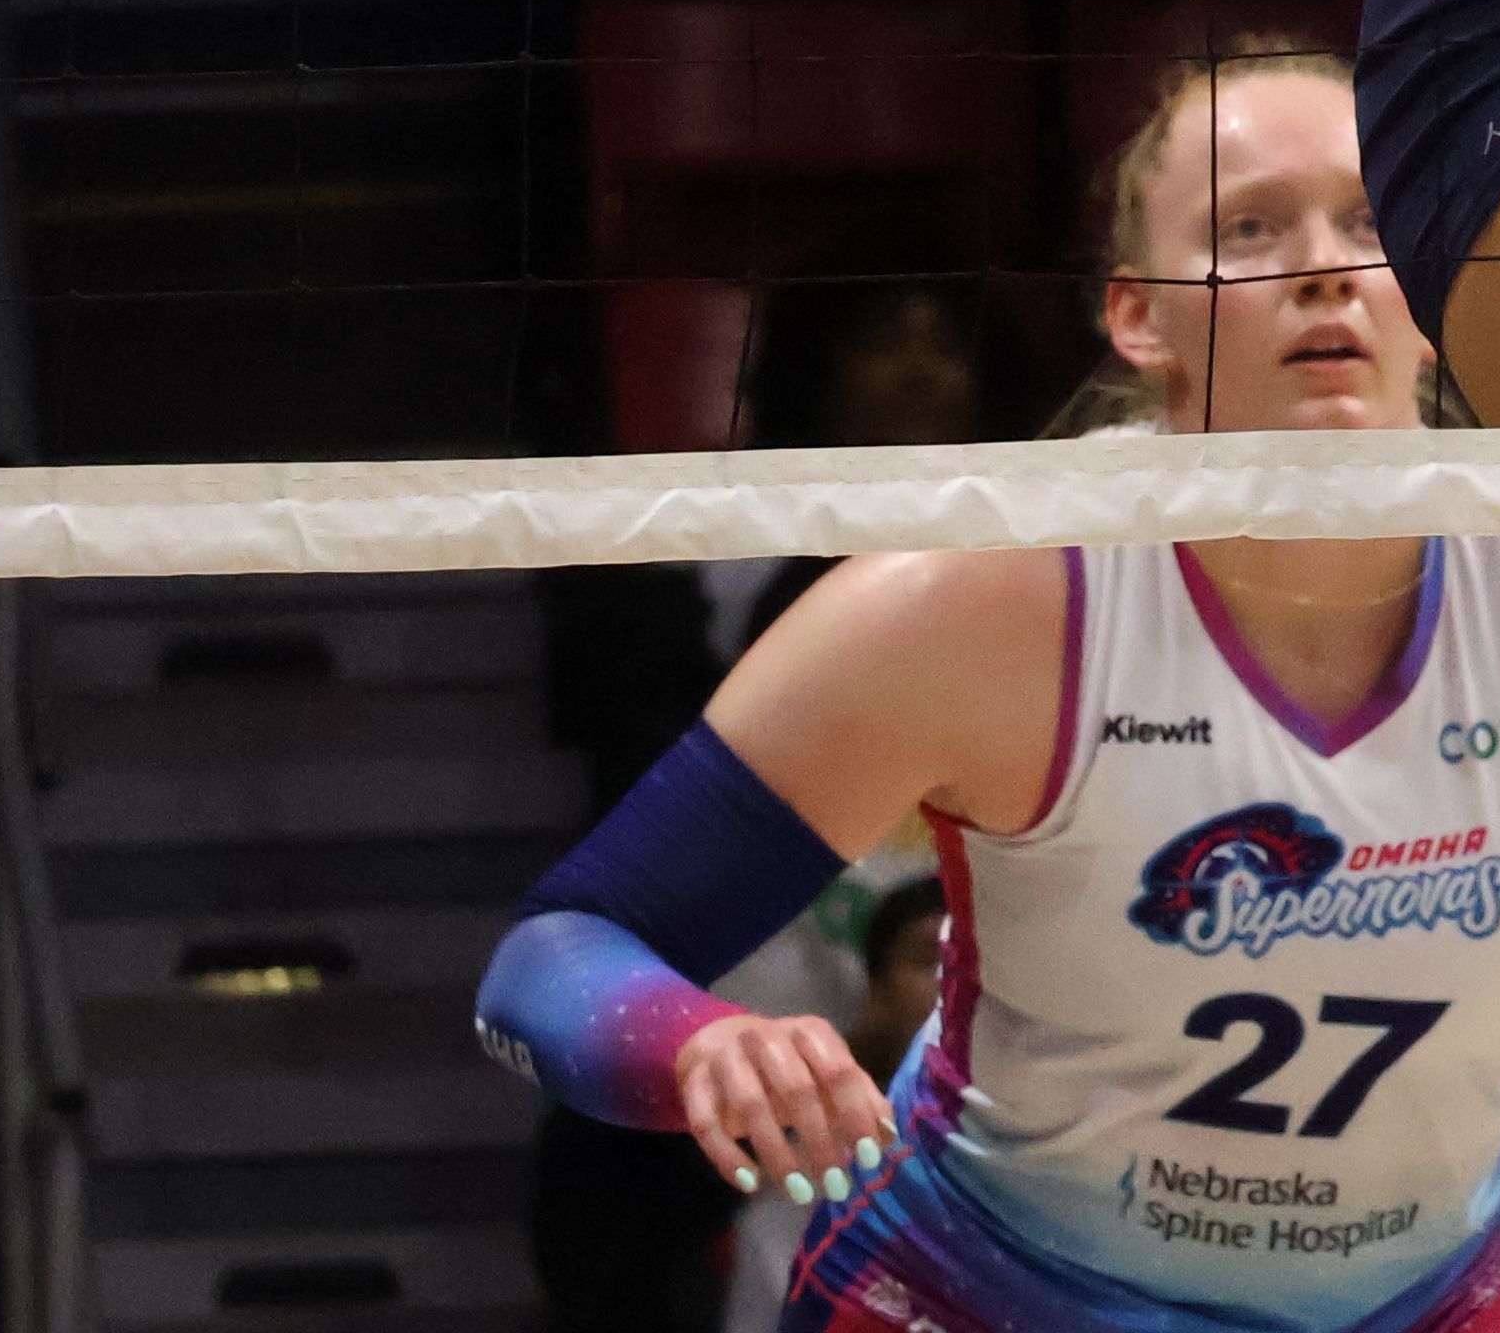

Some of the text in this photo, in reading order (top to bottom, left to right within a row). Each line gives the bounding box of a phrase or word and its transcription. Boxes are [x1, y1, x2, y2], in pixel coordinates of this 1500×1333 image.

[1100, 714, 1213, 744] Kiewit
[1348, 827, 1489, 873] OMAHA
[1164, 993, 1452, 1139] 27
[1148, 1158, 1340, 1207] Nebraska
[1144, 1201, 1421, 1259] Spine Hospital
